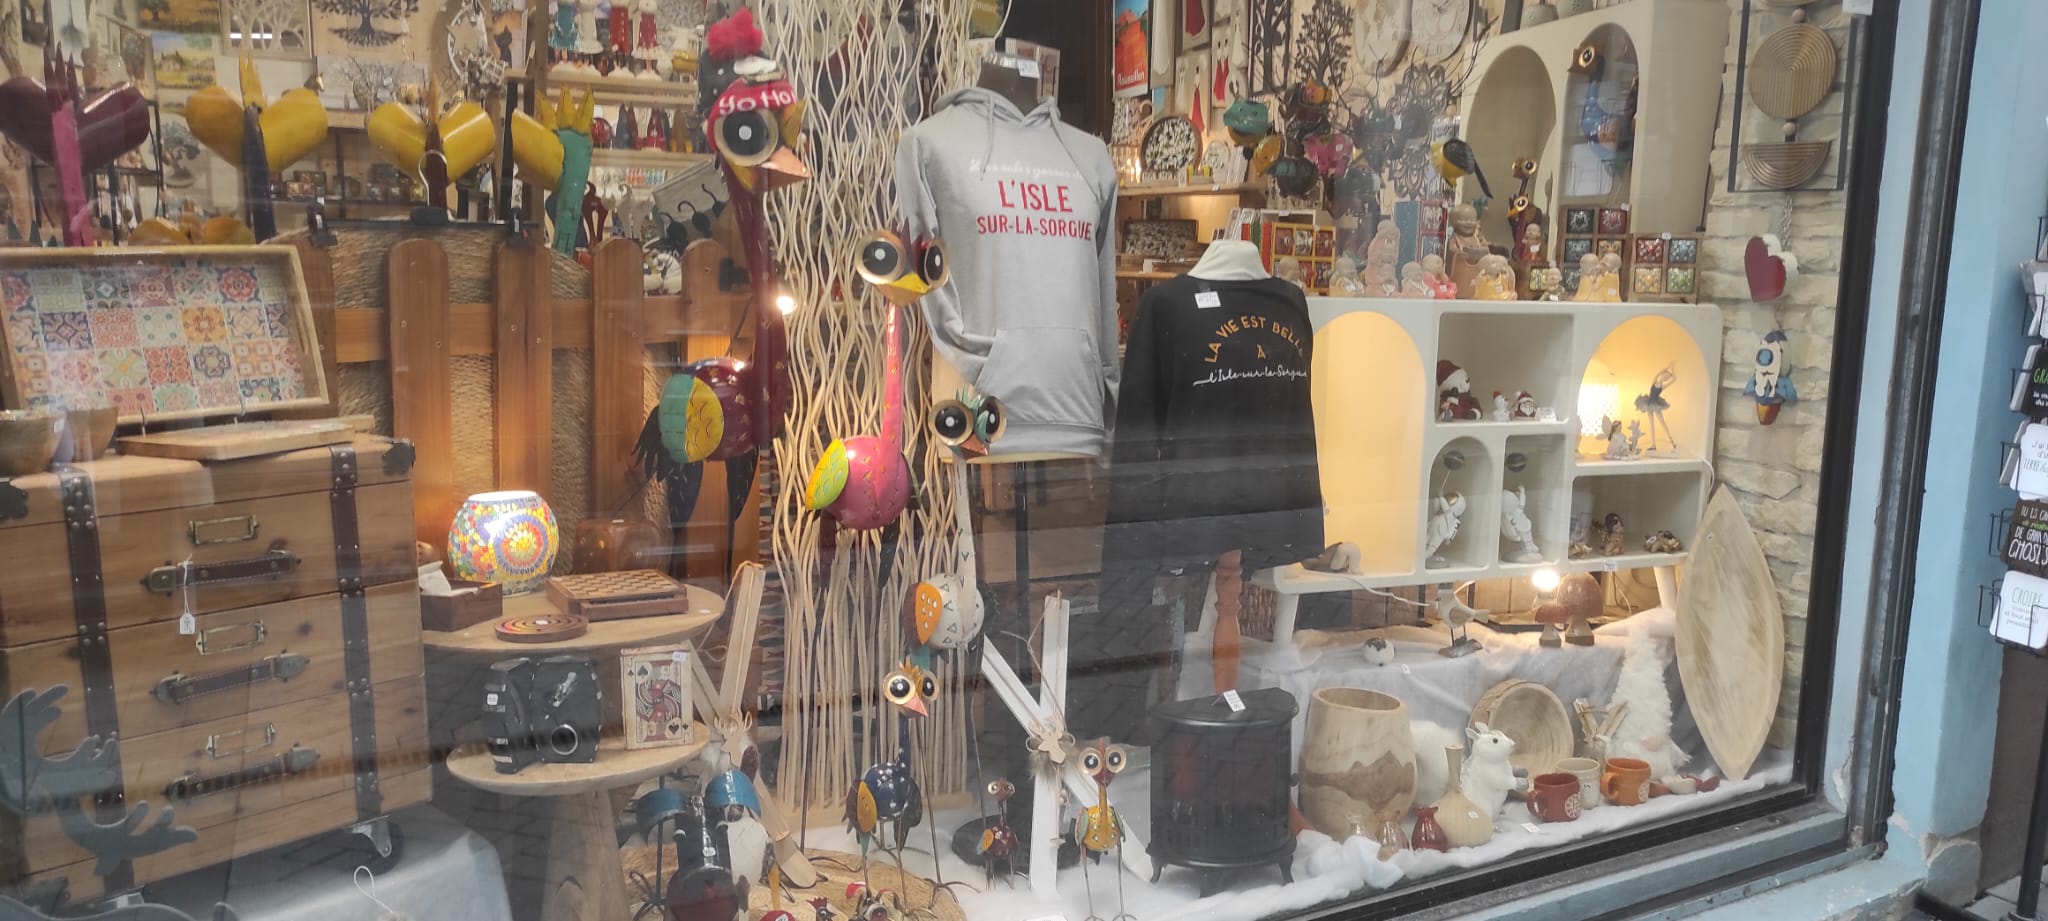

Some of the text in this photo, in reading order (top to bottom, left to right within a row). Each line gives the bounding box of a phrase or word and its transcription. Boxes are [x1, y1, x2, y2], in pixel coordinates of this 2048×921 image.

[998, 180, 1073, 213] L'ISLE
[976, 215, 1092, 241] SUR-LA-SORGUE
[1204, 342, 1222, 363] LA
[1216, 319, 1239, 338] VIE
[1240, 315, 1266, 329] EST
[2015, 526, 2024, 539] DE
